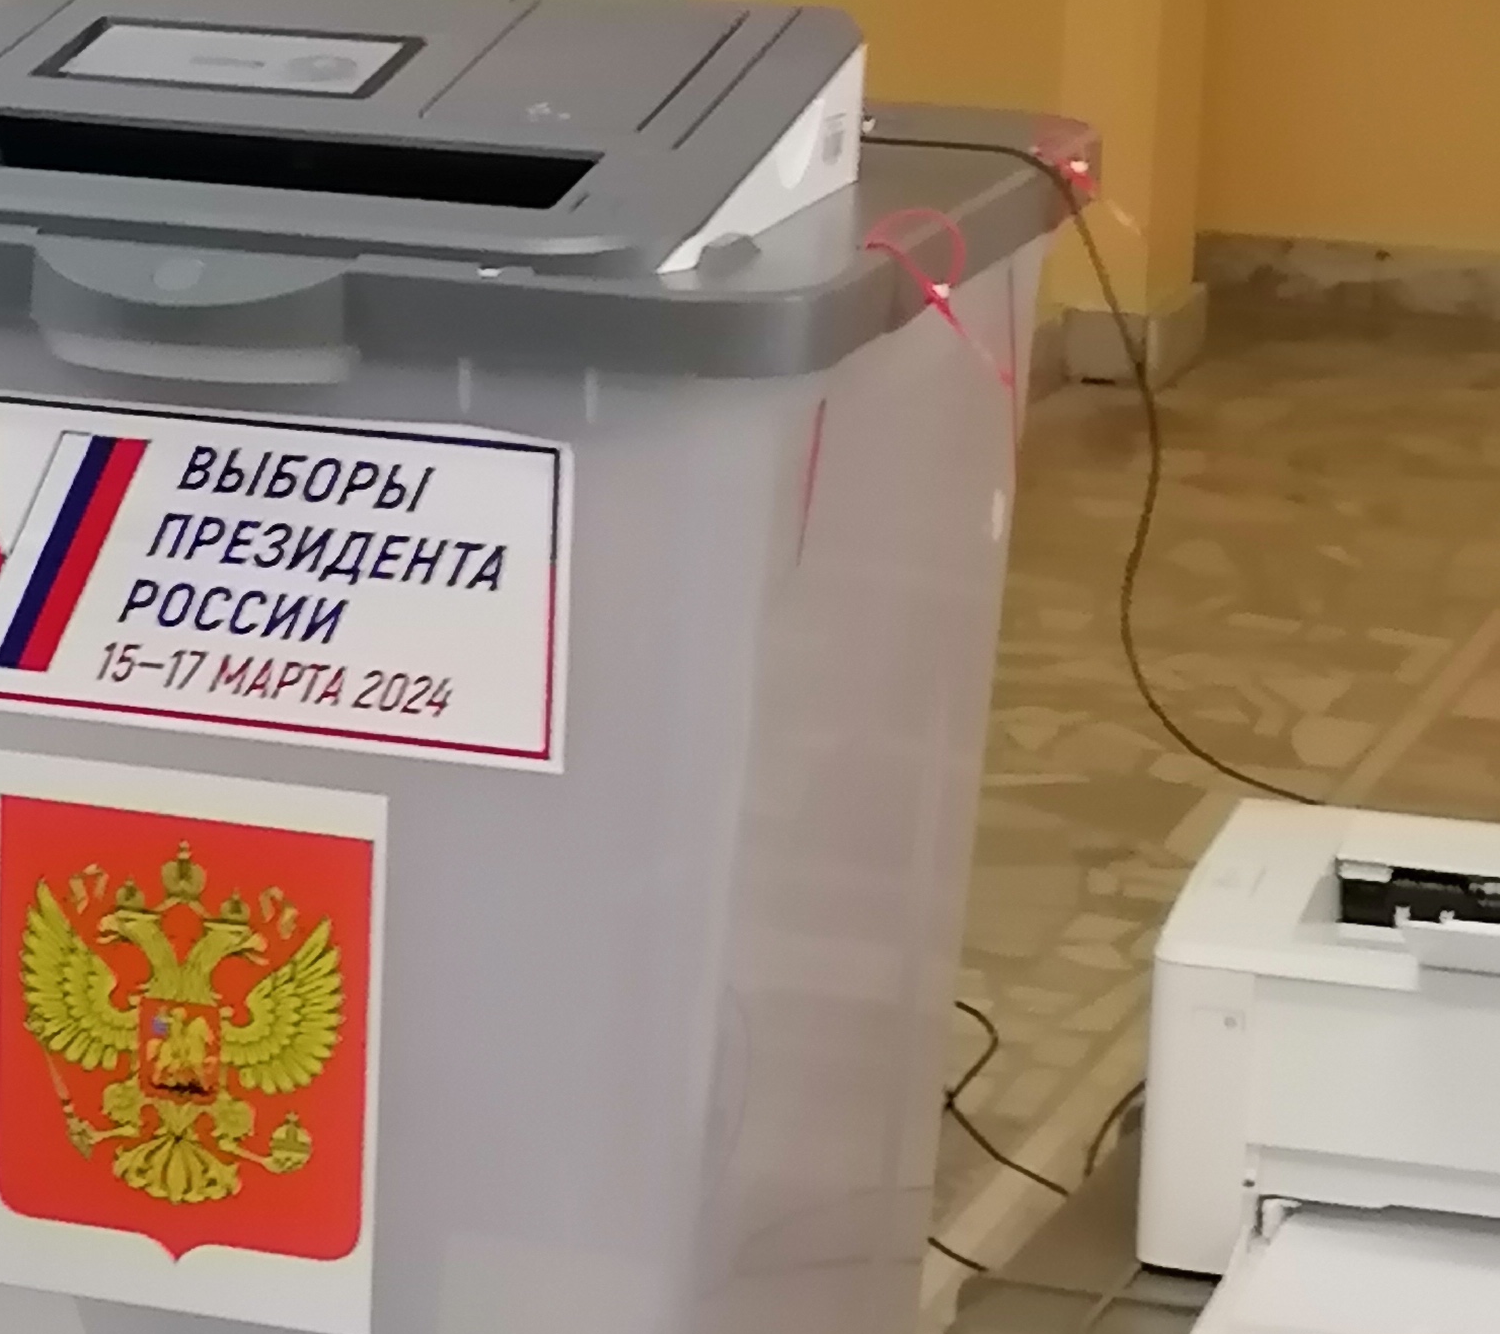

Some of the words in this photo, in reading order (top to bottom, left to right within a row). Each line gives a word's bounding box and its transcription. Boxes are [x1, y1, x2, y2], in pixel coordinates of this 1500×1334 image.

[177, 445, 436, 513] ВЫБОРЫ
[146, 512, 509, 593] ПРЕЗИДЕНТА
[117, 578, 350, 645] РОССИИ
[209, 653, 346, 707] МАРТА
[350, 668, 454, 719] 2024
